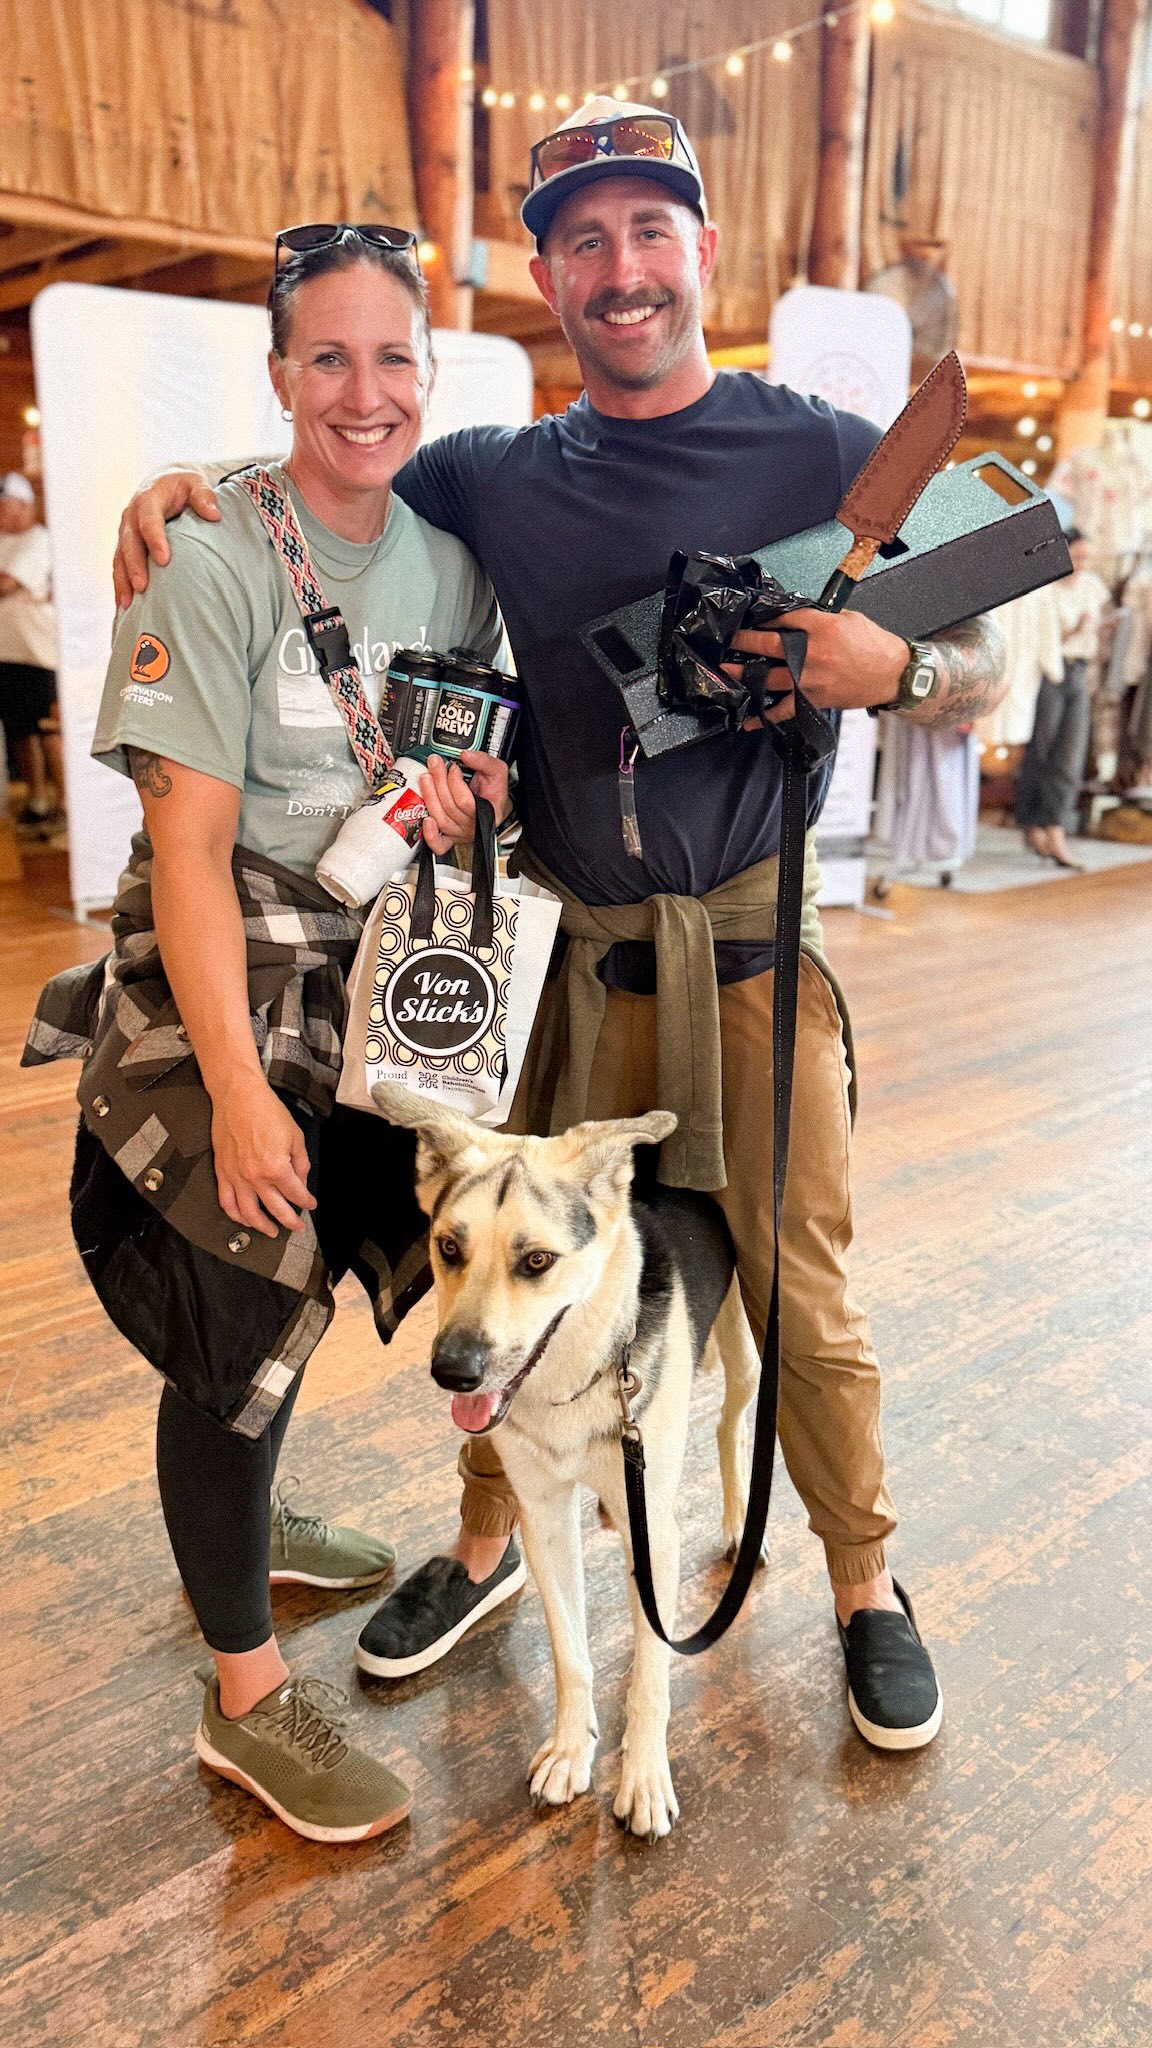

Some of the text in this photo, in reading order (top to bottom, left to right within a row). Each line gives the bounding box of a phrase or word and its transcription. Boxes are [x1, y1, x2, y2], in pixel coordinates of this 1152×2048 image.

[278, 625, 433, 676] Grslad
[438, 703, 476, 724] COLD
[435, 716, 474, 737] BREW
[286, 800, 337, 818] Don't
[413, 971, 471, 996] Von
[395, 997, 485, 1024] Slick's
[376, 1069, 408, 1080] Proud
[441, 1075, 474, 1084] Children's
